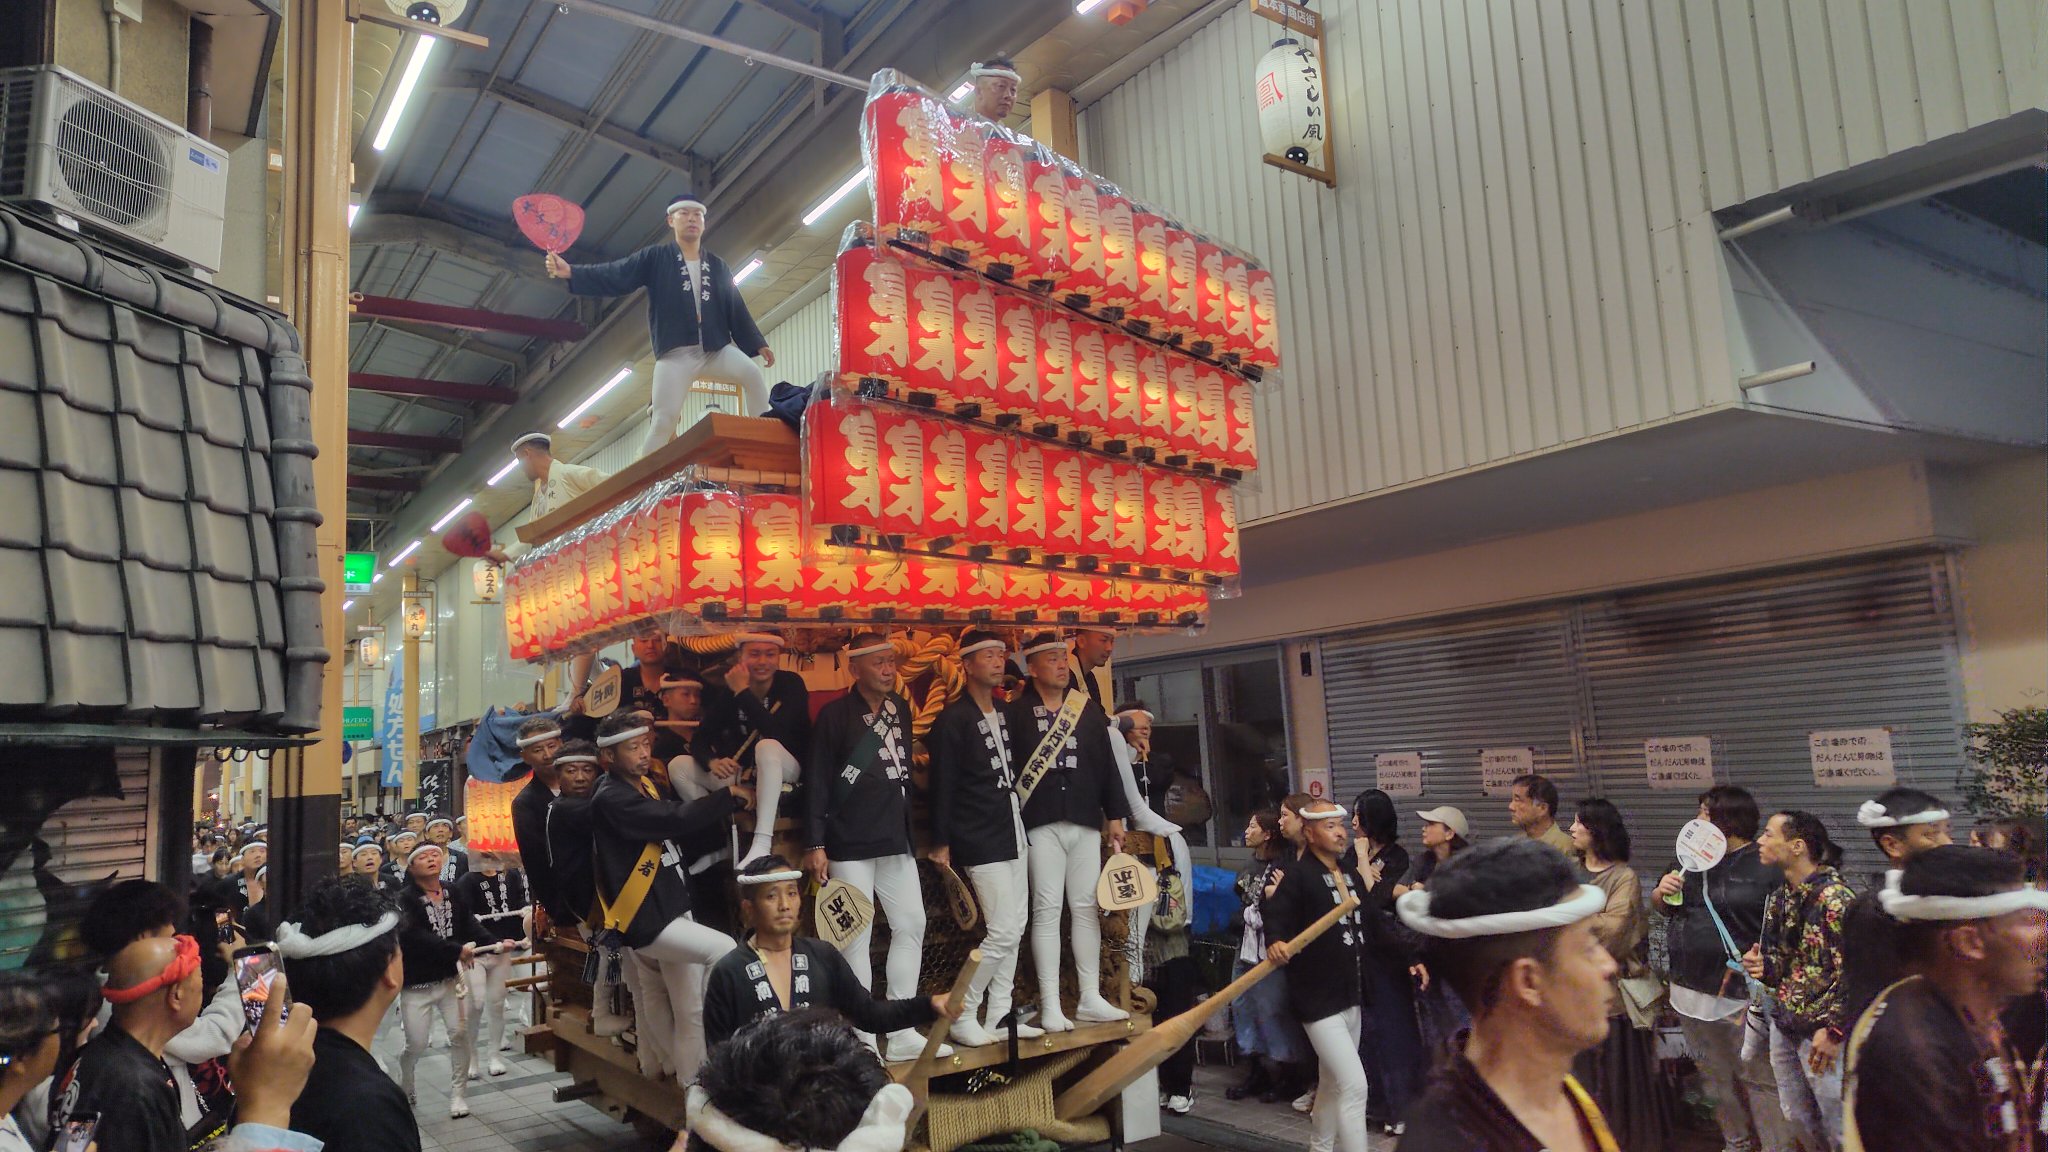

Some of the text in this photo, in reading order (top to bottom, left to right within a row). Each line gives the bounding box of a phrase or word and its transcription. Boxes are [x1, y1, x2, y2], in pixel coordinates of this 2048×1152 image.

[1294, 46, 1324, 141] やさしい風
[701, 261, 711, 301] 大工方
[638, 859, 656, 878] 者
